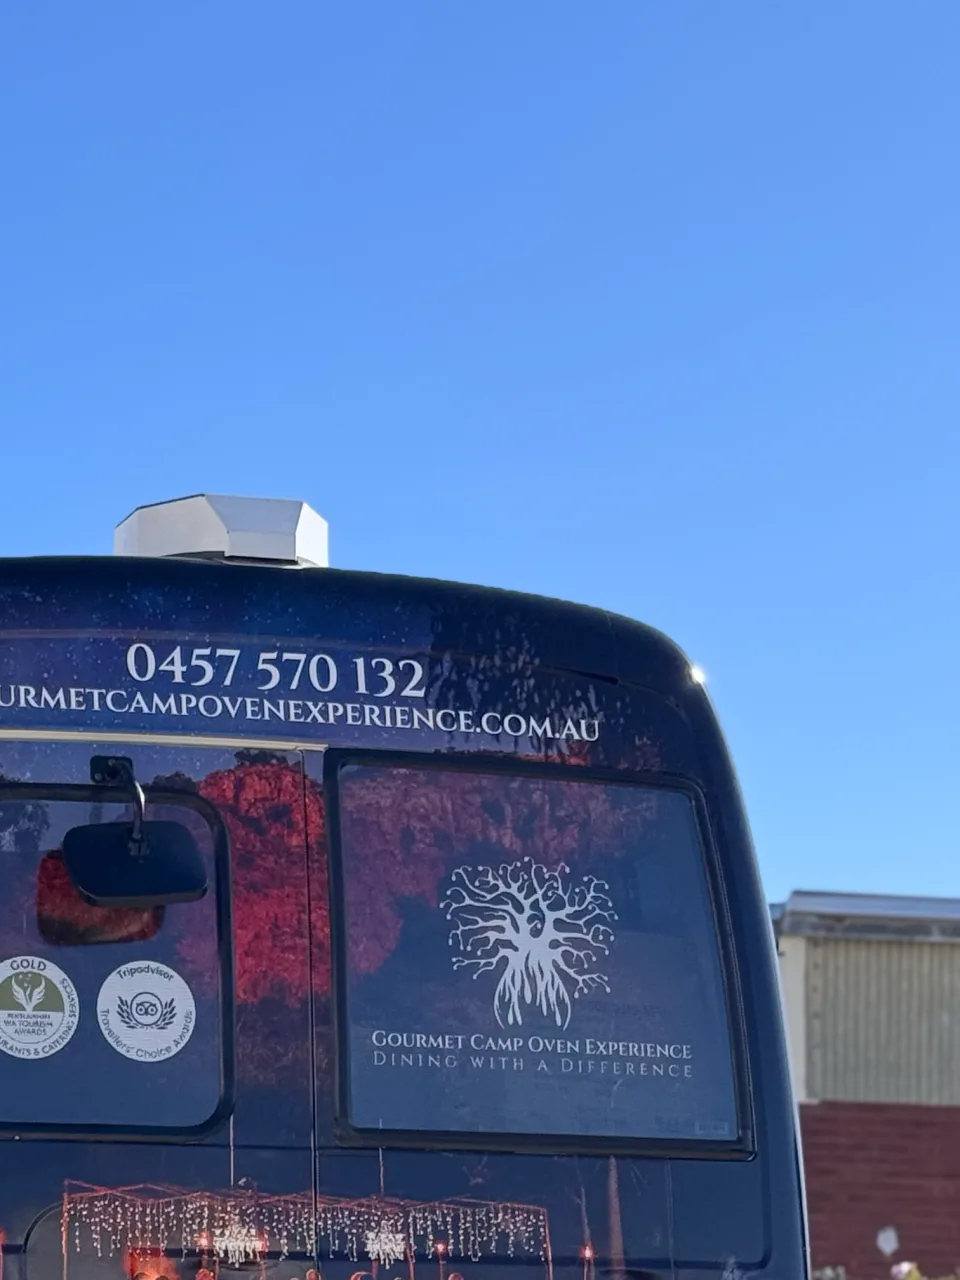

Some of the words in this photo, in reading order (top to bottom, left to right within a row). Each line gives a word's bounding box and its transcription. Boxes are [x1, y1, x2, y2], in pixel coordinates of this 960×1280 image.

[126, 642, 240, 687] 0457
[255, 650, 339, 693] 570
[353, 656, 427, 698] 132
[10, 959, 47, 971] GOLD
[116, 964, 175, 982] Tripadvisor
[14, 1027, 47, 1036] AWARDS
[135, 1045, 172, 1059] Choice
[173, 1009, 193, 1048] Awards
[33, 1047, 41, 1057] &
[537, 1059, 549, 1072] A
